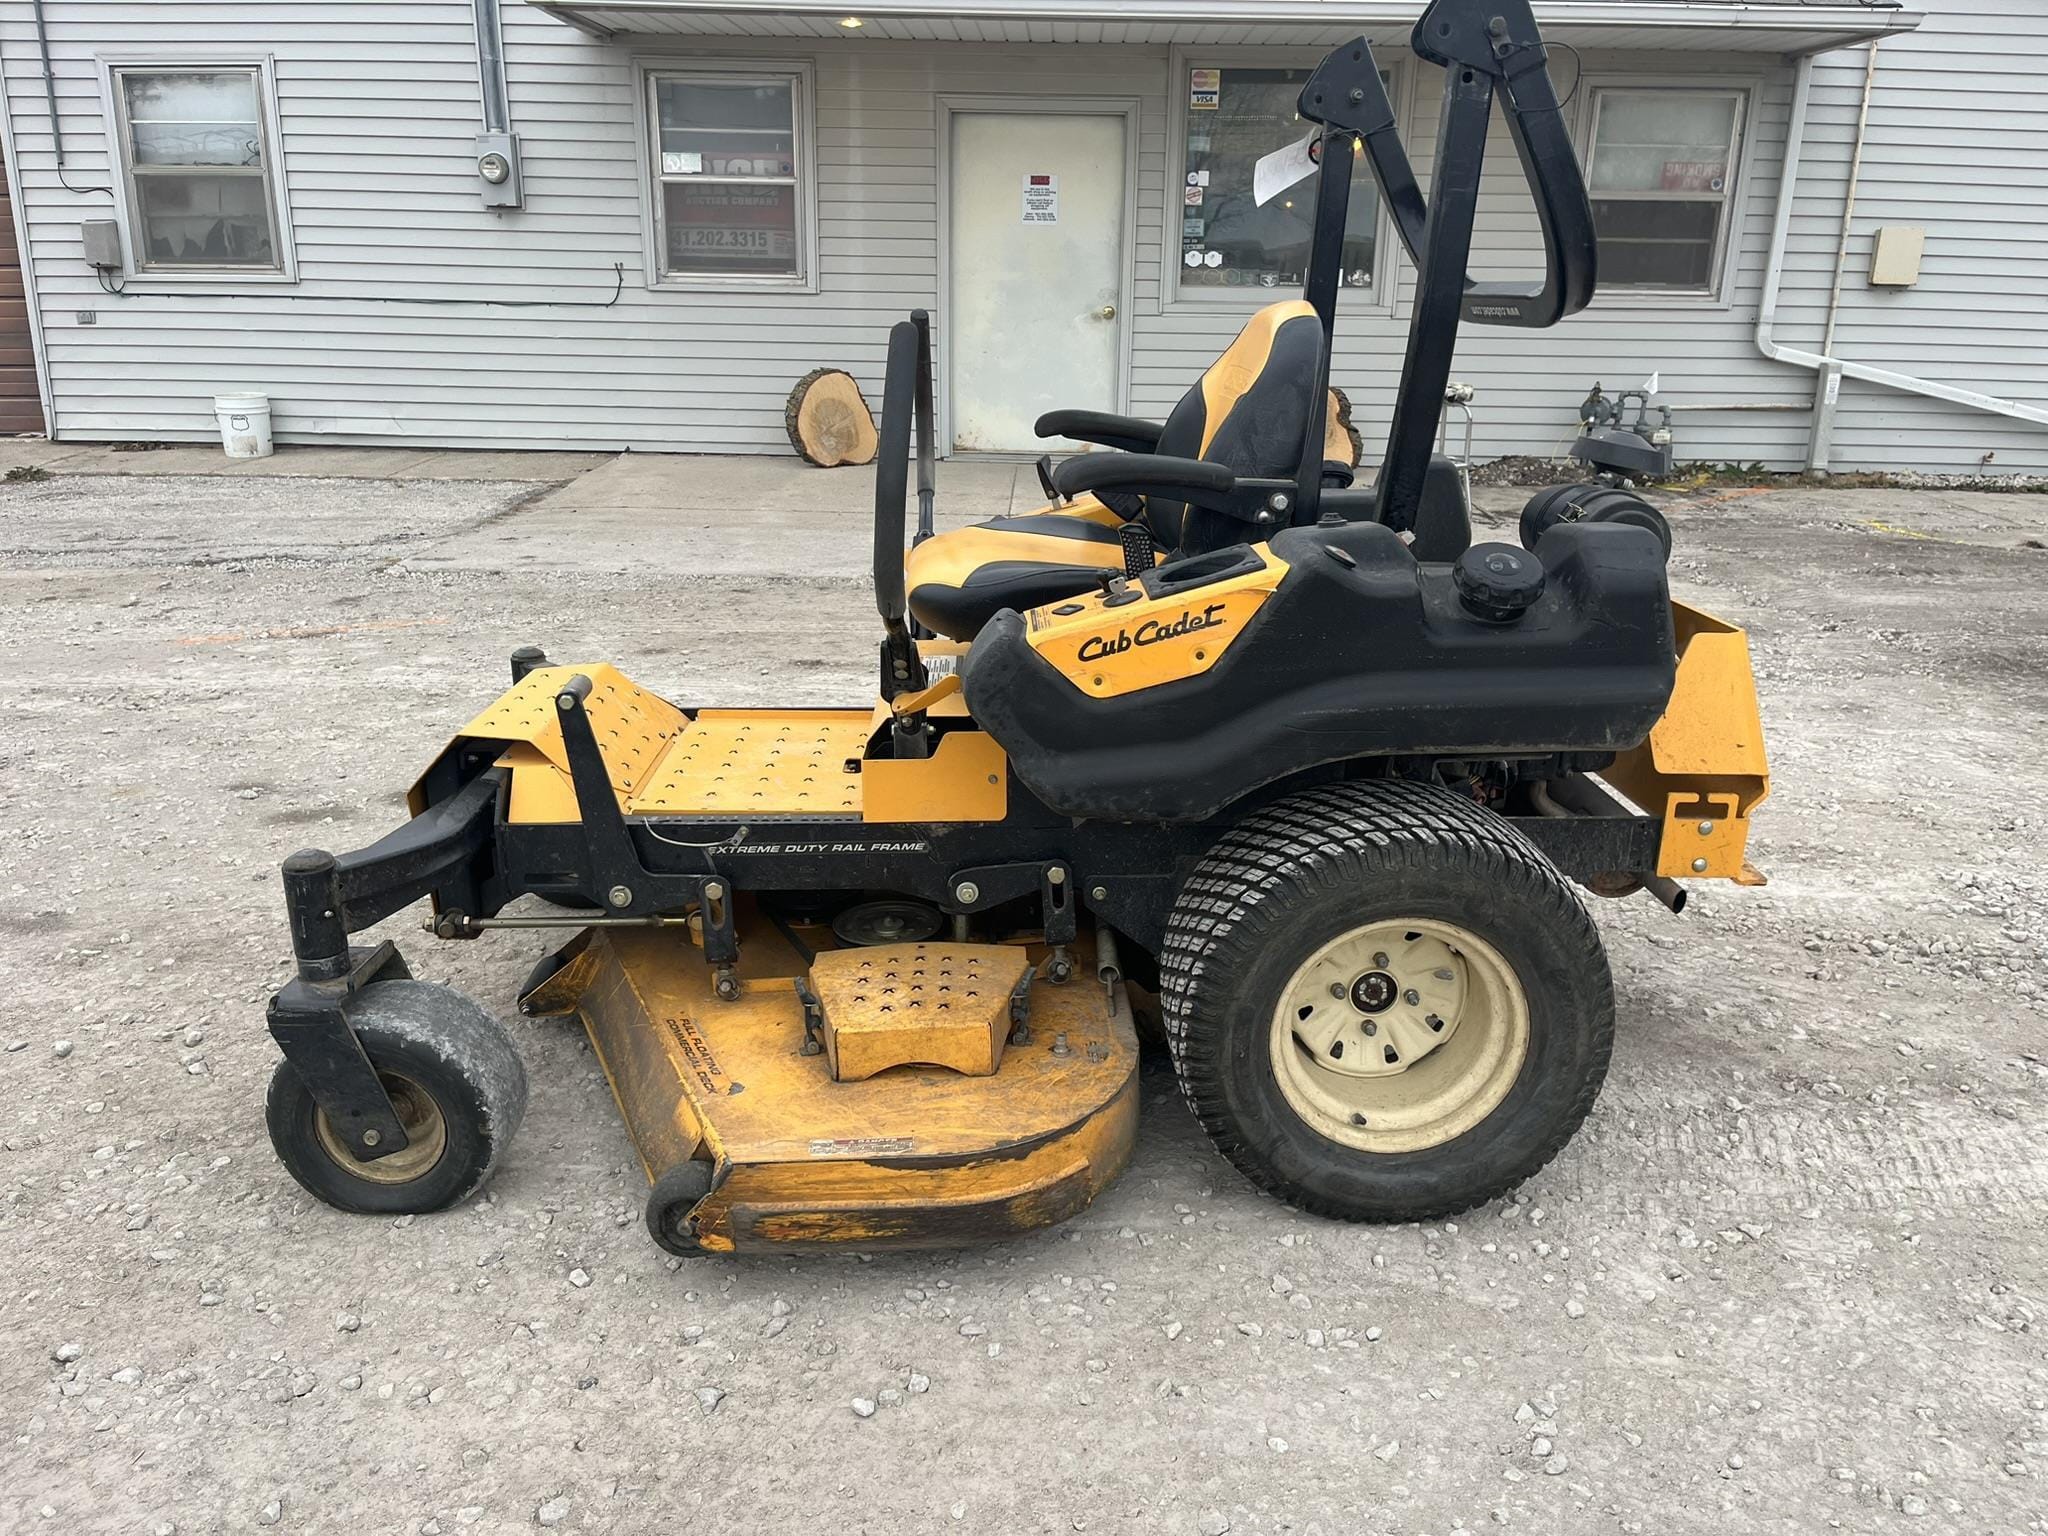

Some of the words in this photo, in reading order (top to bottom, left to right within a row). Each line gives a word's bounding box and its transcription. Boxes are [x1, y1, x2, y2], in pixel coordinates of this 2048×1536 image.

[1196, 95, 1213, 103] VISA
[1665, 163, 1721, 176] SMOKING
[1078, 629, 1131, 663] Cub
[1134, 603, 1226, 646] Cadet
[708, 845, 780, 855] EXTREME
[784, 844, 827, 853] DUTY
[832, 843, 866, 852] RAIL
[870, 842, 926, 851] FRAME
[666, 1018, 702, 1070] COMMERCIAL
[697, 1071, 718, 1095] DECK
[680, 1018, 696, 1037] FULL
[691, 1037, 722, 1076] FLOATING
